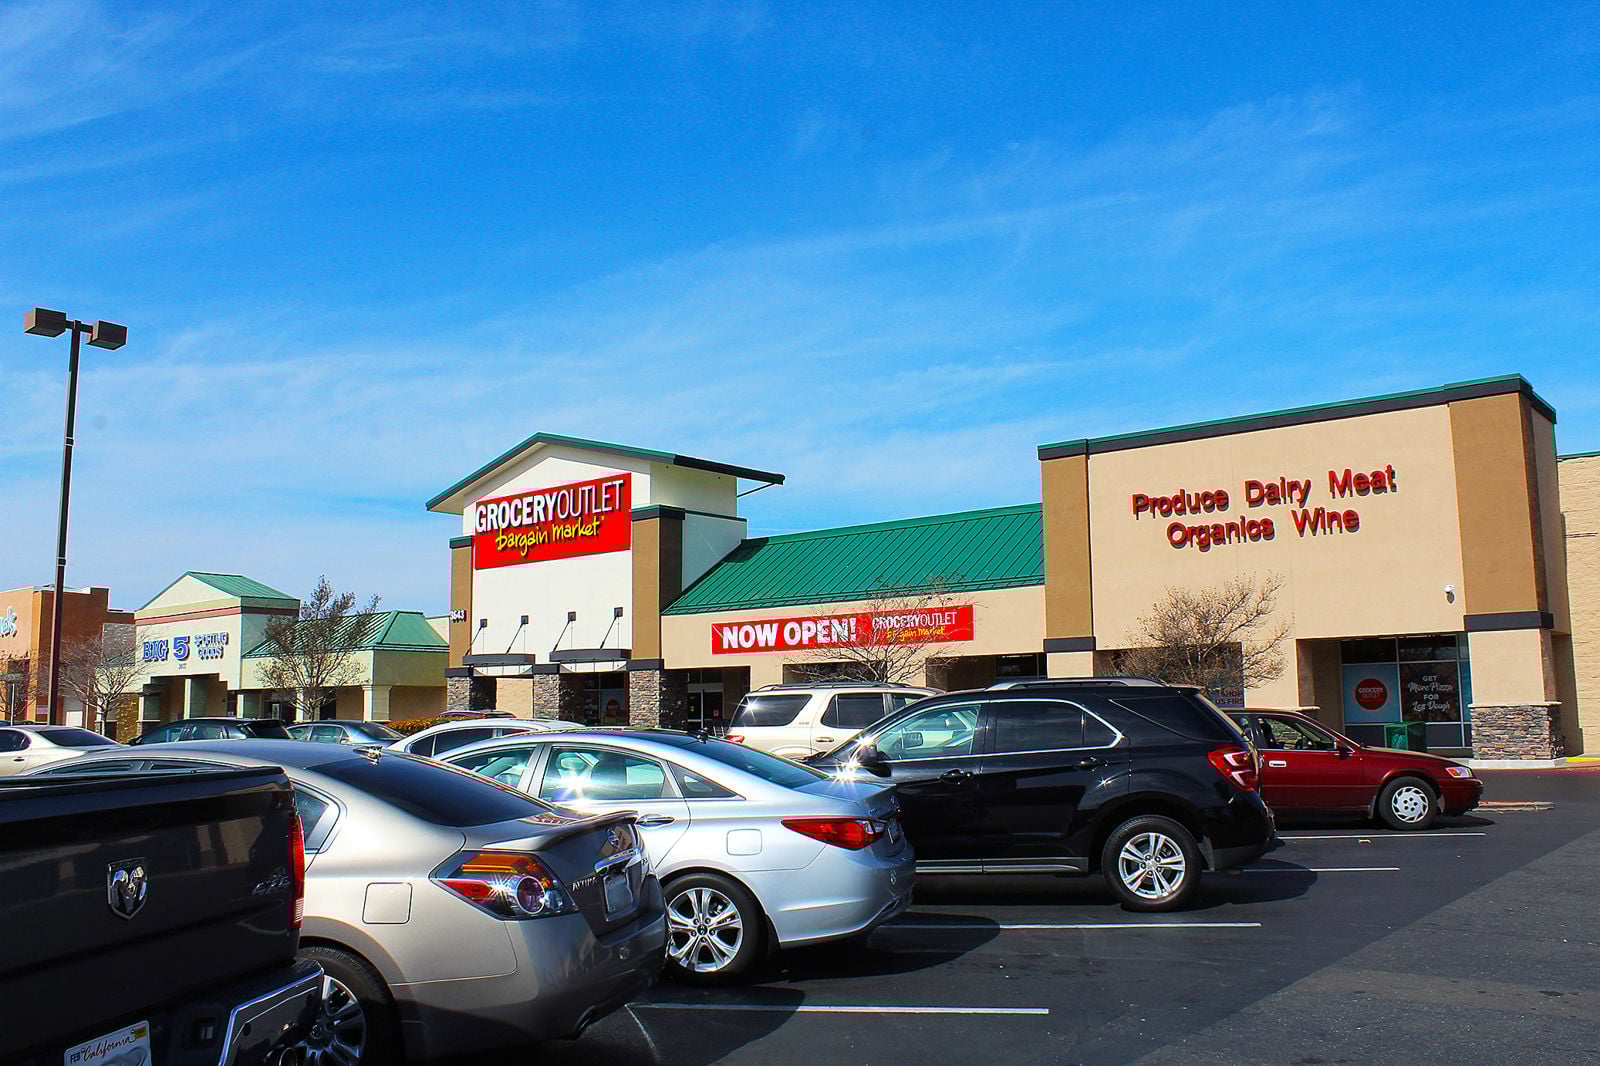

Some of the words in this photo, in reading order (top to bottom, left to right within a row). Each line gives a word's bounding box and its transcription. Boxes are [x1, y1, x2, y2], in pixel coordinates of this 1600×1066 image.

[1131, 488, 1229, 518] Produce
[1244, 476, 1311, 507] Dairy
[1328, 464, 1396, 498] Meat
[495, 523, 548, 557] bargain
[551, 515, 601, 542] market
[1166, 515, 1275, 551] Organics
[1291, 506, 1360, 537] Wine
[143, 640, 168, 661] BIG
[173, 636, 190, 661] 5
[722, 622, 779, 649] NOW
[783, 617, 857, 646] OPEN!
[1407, 681, 1429, 693] More
[1429, 681, 1453, 692] Pizza
[70, 1052, 81, 1064] FEB
[81, 1036, 136, 1062] California
